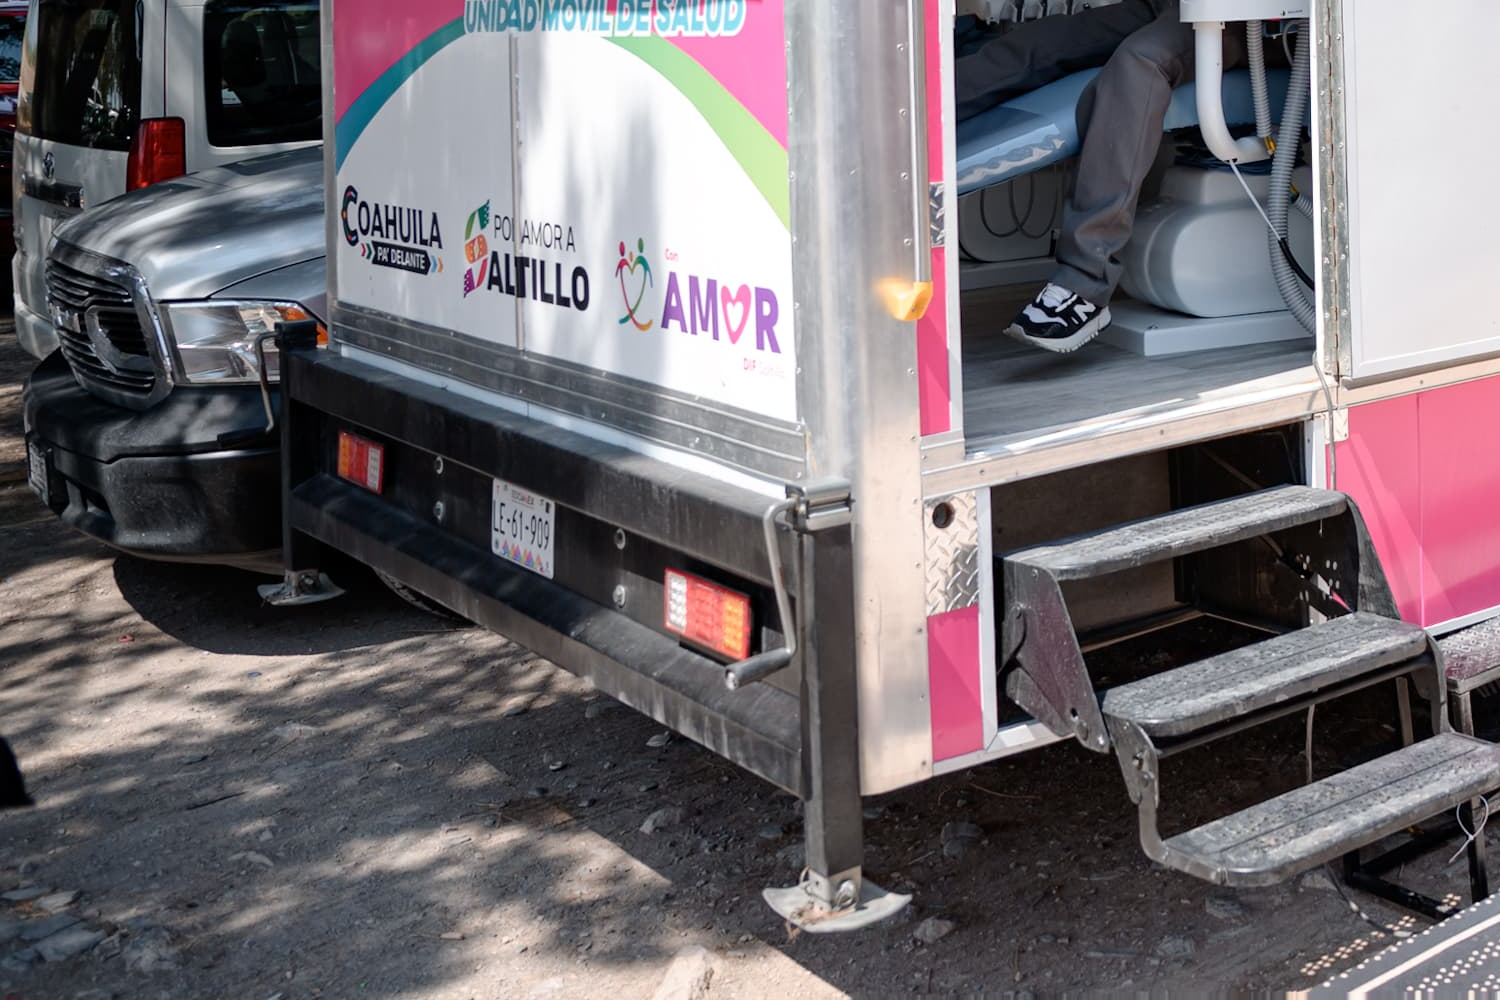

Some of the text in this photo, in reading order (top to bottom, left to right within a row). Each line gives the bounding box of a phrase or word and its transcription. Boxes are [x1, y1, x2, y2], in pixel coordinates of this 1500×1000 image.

[520, 218, 563, 250] AMOR
[566, 226, 576, 252] A
[390, 248, 426, 270] DELANTE
